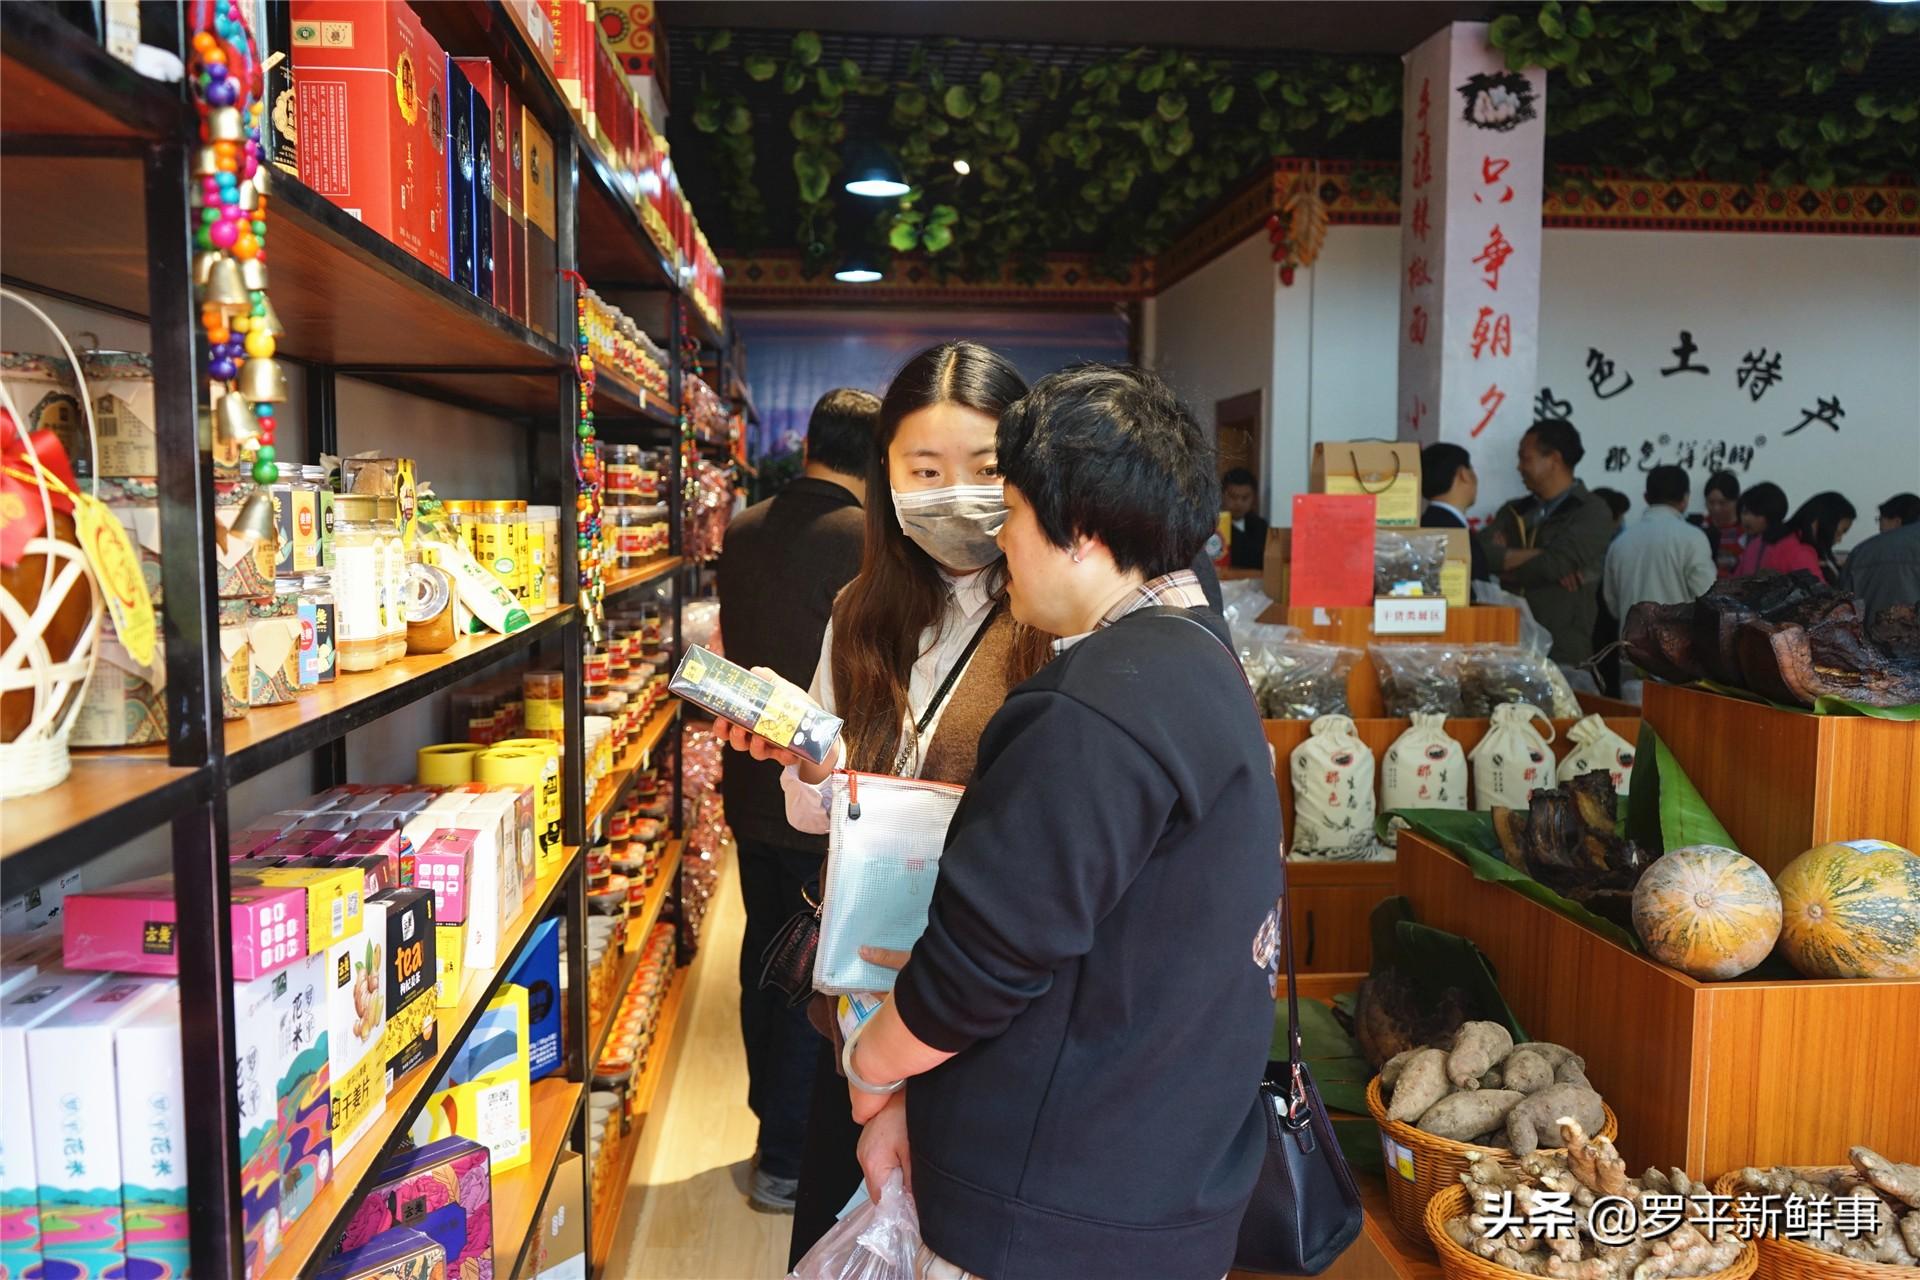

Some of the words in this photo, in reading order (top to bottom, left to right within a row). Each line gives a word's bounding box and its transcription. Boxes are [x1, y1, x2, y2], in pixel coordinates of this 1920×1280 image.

[1470, 155, 1514, 438] 只争朝夕
[342, 1075, 370, 1120] 干姜片
